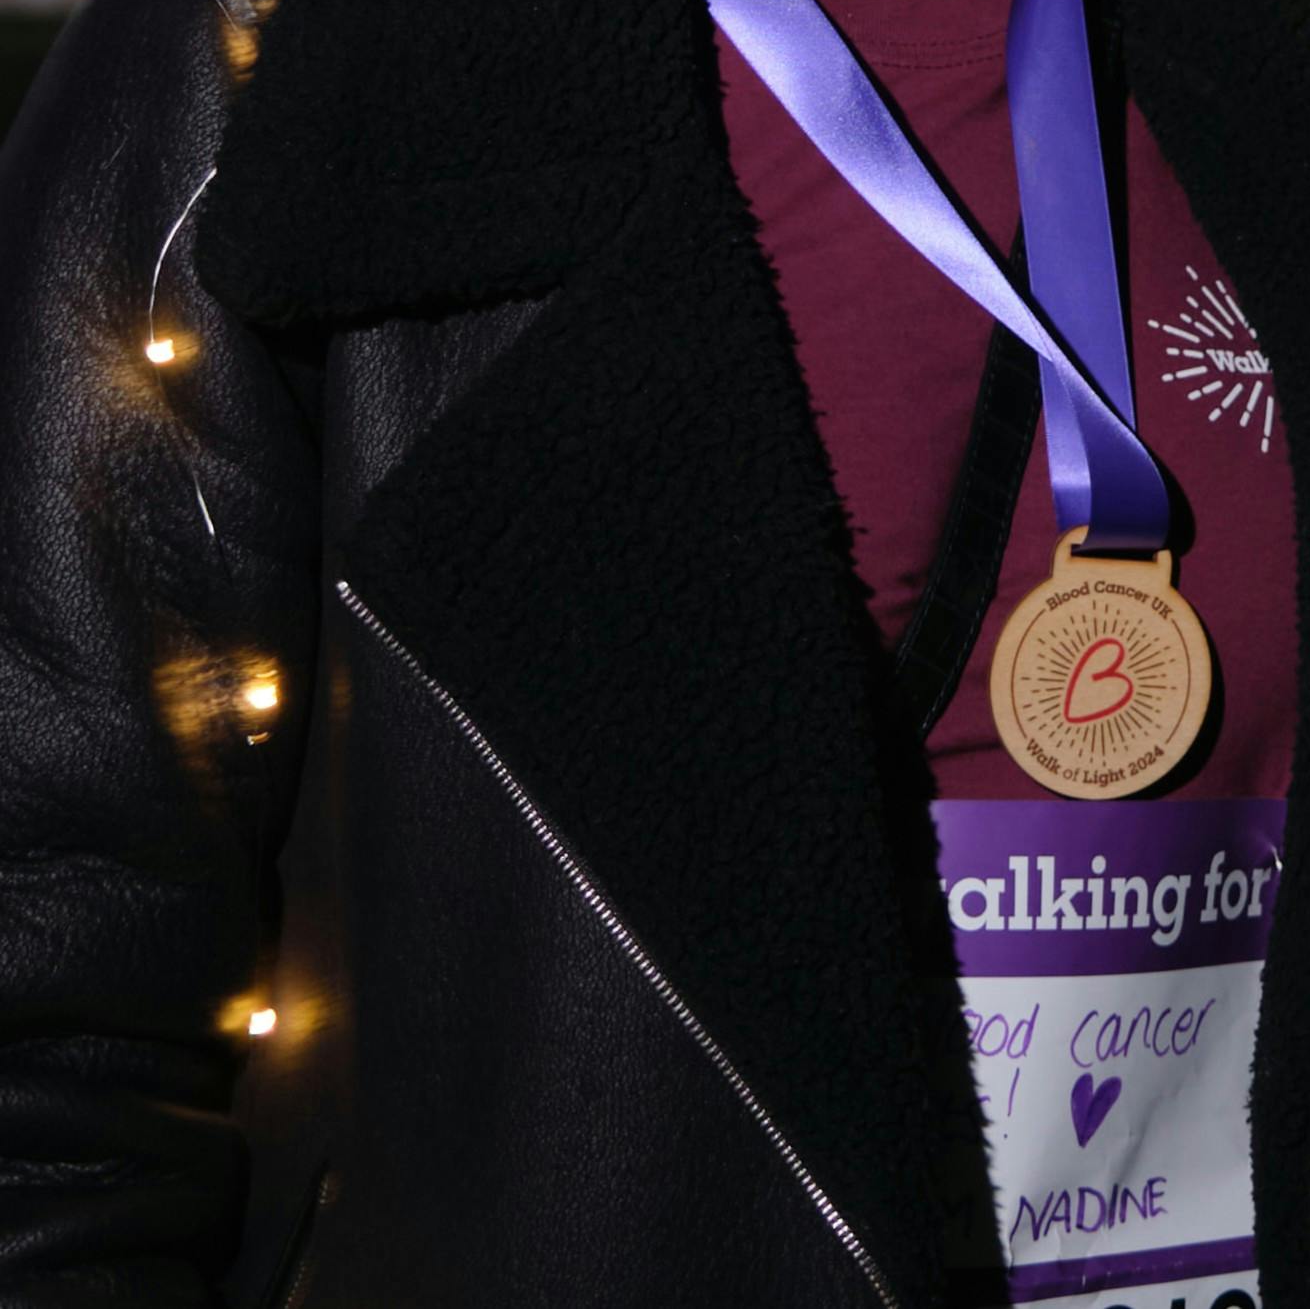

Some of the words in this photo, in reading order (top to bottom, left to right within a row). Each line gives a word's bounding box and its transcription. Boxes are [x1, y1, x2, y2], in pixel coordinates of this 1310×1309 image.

[1045, 582, 1091, 612] Blood
[1094, 580, 1149, 604] Cancer
[1150, 597, 1173, 620] UK
[1026, 739, 1062, 775] Walk
[1062, 767, 1081, 782] of
[1083, 769, 1126, 787] Light
[1129, 746, 1165, 775] 2024
[940, 855, 1191, 946] alking
[1200, 850, 1272, 923] for
[1070, 998, 1216, 1069] cancer
[1009, 1176, 1167, 1242] NADINE
